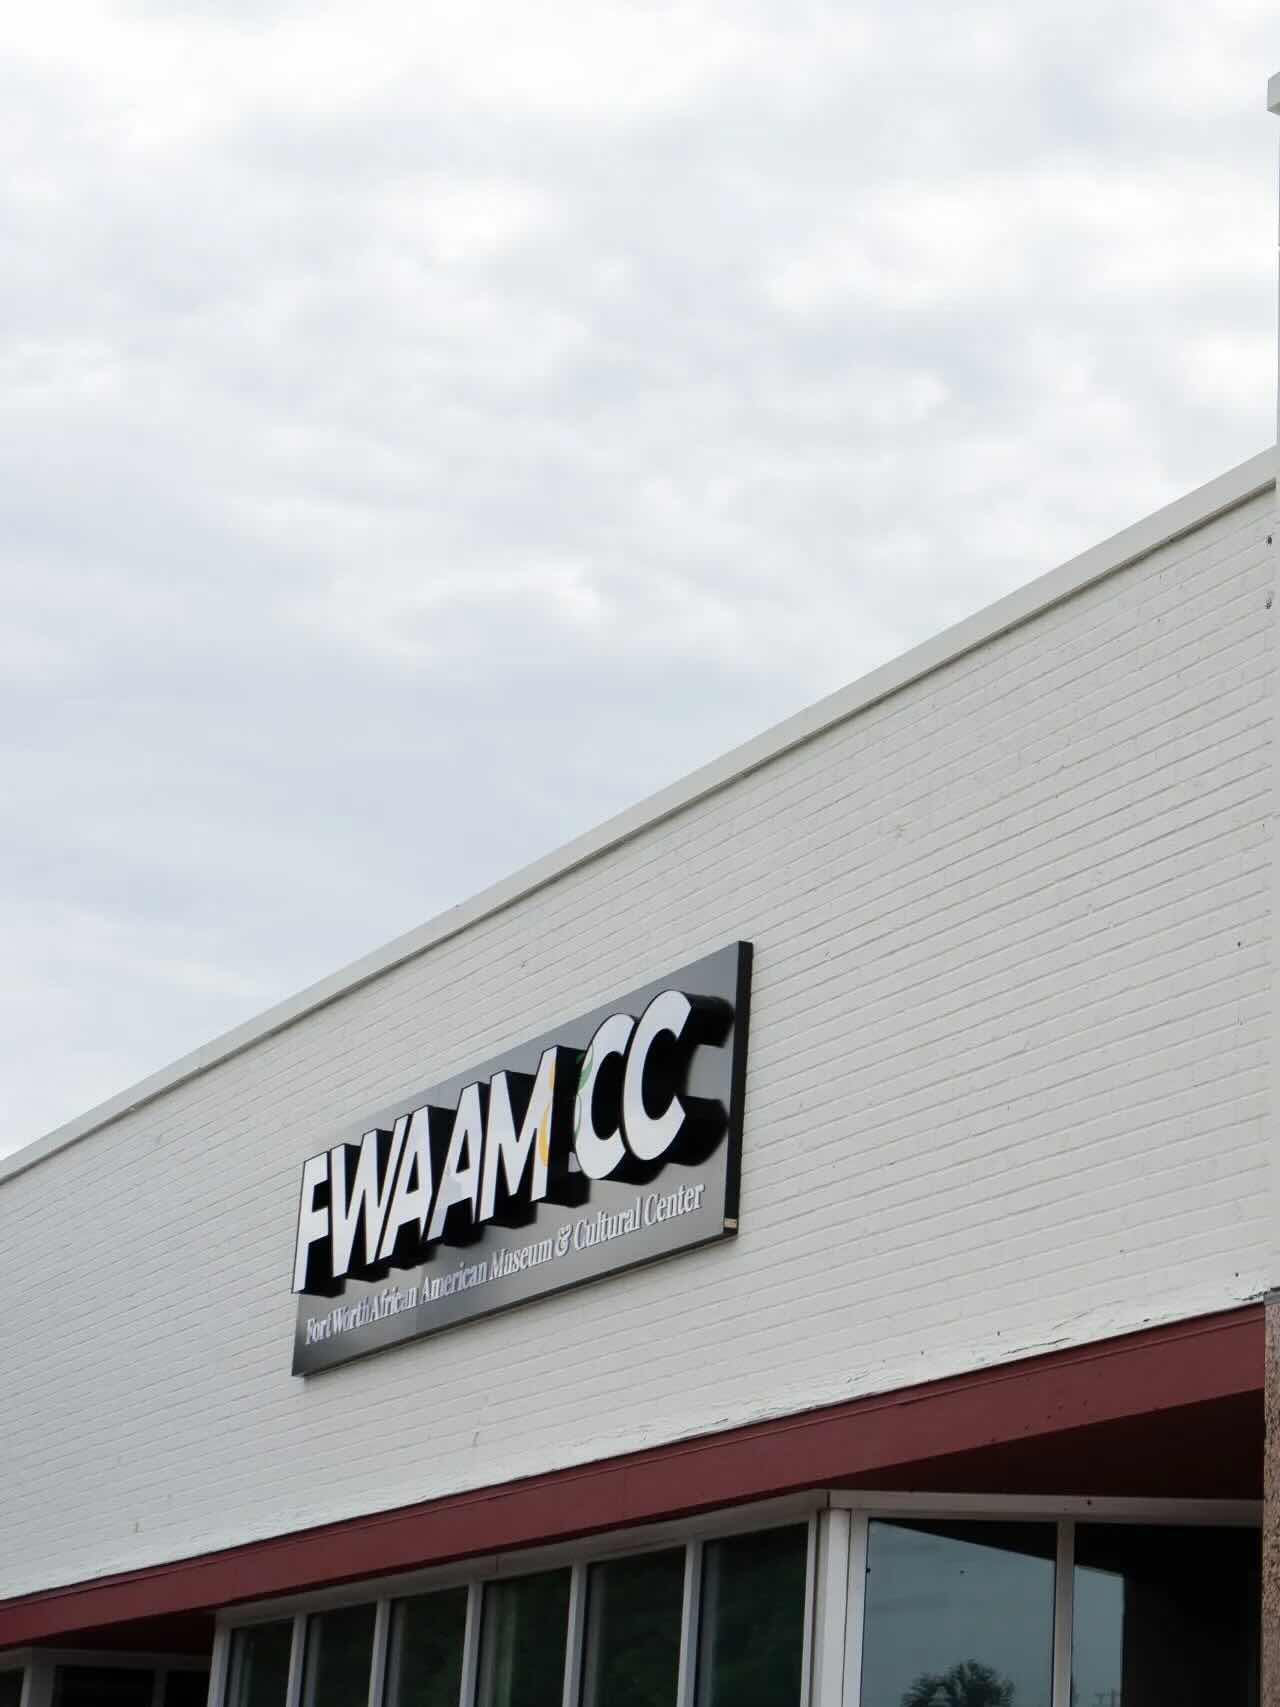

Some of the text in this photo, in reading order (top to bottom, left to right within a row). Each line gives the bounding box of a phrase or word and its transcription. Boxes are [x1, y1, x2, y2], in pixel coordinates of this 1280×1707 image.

[305, 1183, 705, 1345] Fort Worth African American Museum & Cultural Center
